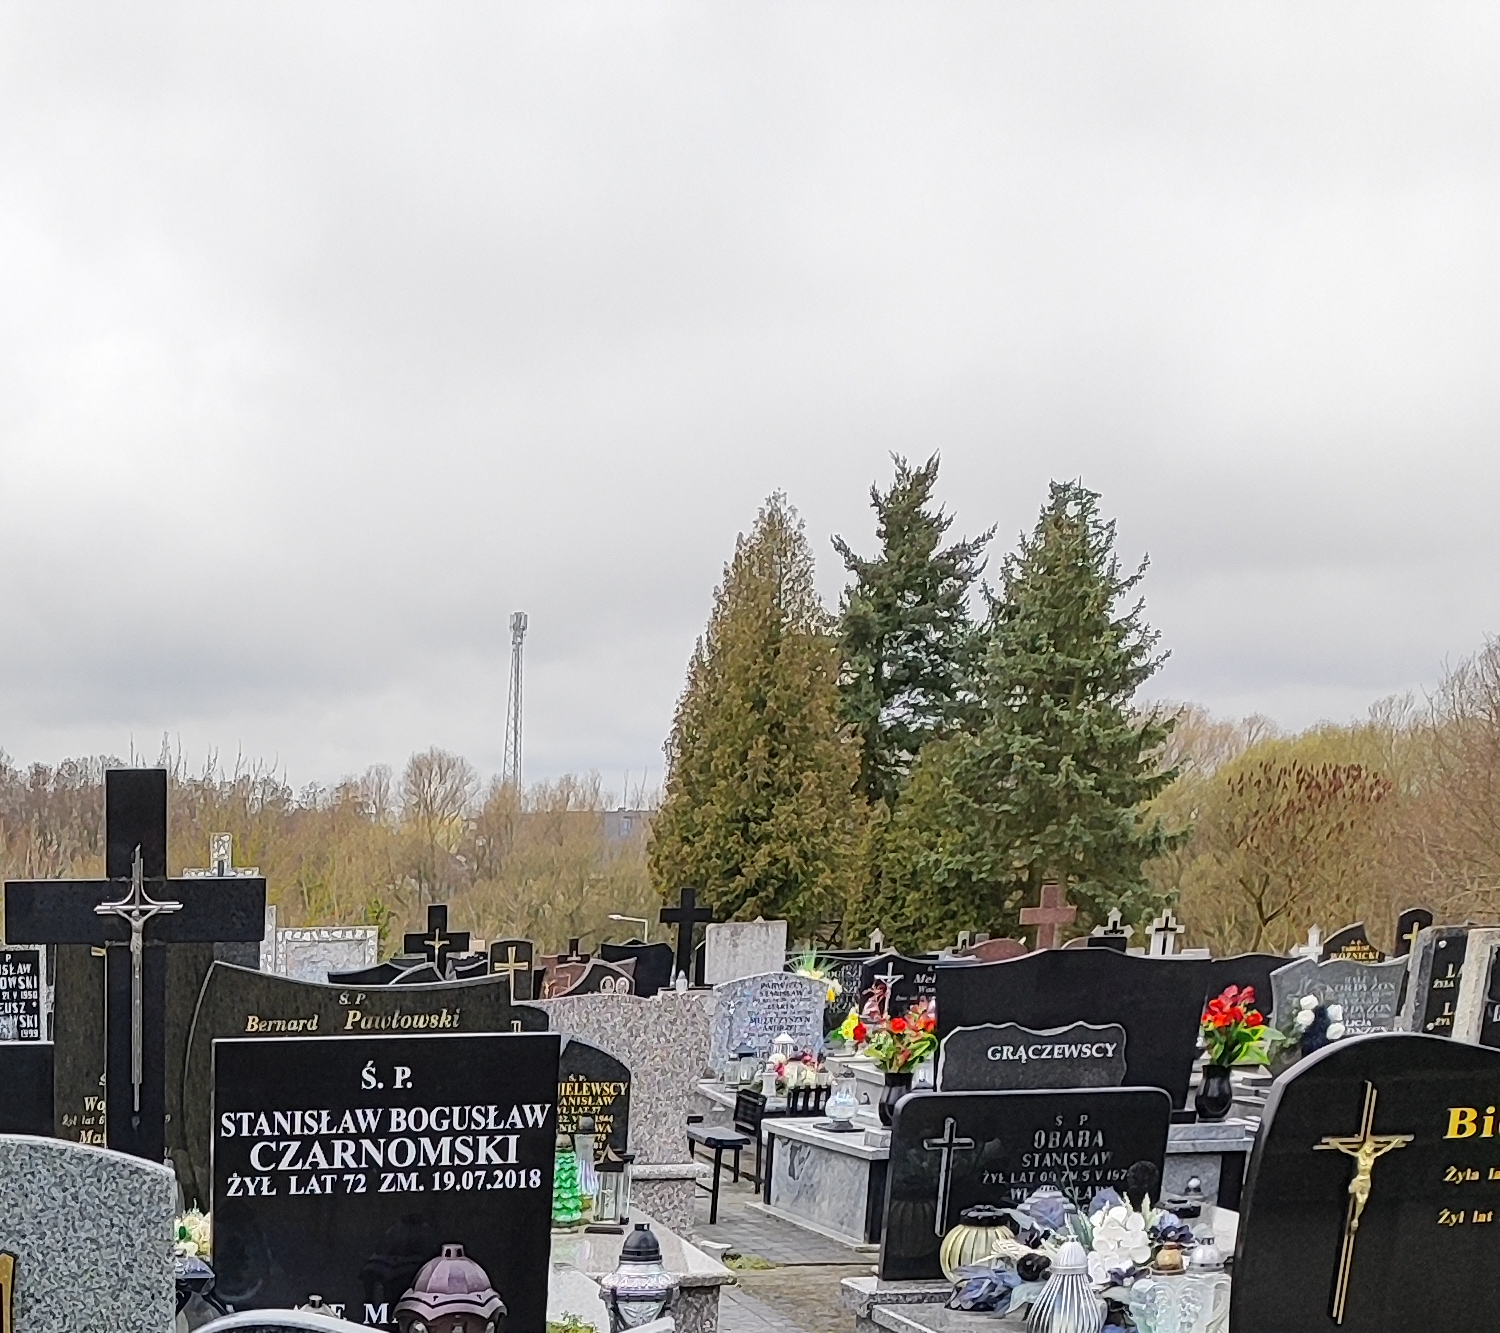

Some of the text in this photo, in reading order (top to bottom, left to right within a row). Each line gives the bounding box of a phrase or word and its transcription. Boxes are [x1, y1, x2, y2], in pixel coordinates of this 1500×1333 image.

[245, 1008, 461, 1032] Bernard Pawłowski
[987, 1042, 1118, 1064] GRĄCZEWSCY
[220, 1108, 385, 1138] STANISŁAW
[388, 1103, 552, 1133] BOGUSŁAW
[1442, 1106, 1500, 1139] Bi
[249, 1134, 521, 1172] CZARNOMSKI
[1022, 1151, 1113, 1168] STANISŁAW
[226, 1168, 543, 1197] ŻYŁ LAT 72 ZM. 19.07.2018
[1010, 1171, 1036, 1183] LAT
